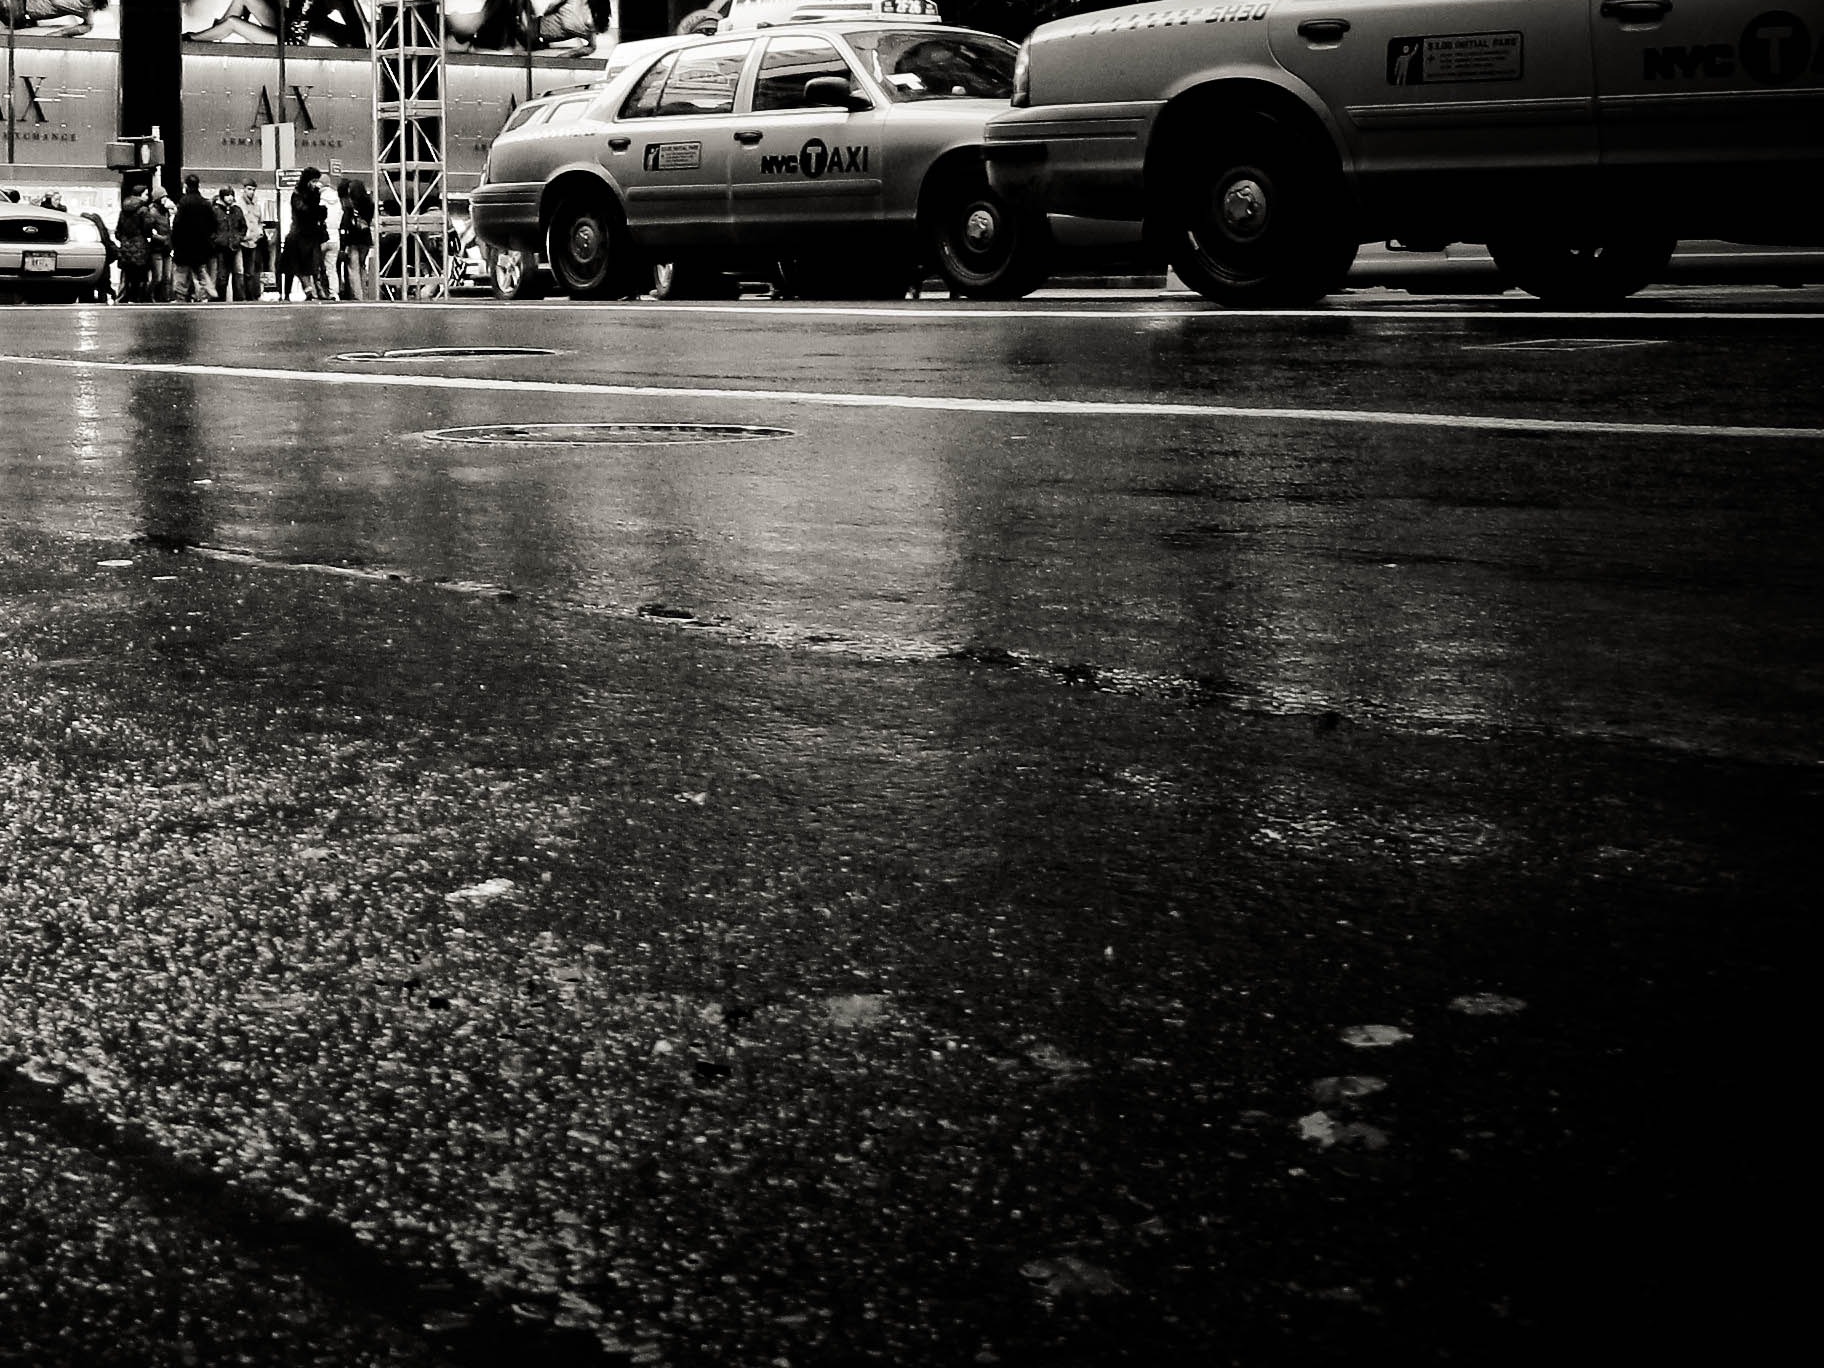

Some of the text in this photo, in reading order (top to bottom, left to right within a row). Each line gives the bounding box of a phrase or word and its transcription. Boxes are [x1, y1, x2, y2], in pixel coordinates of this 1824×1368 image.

[1643, 43, 1735, 81] NYC
[760, 139, 869, 178] NYC TAXI
